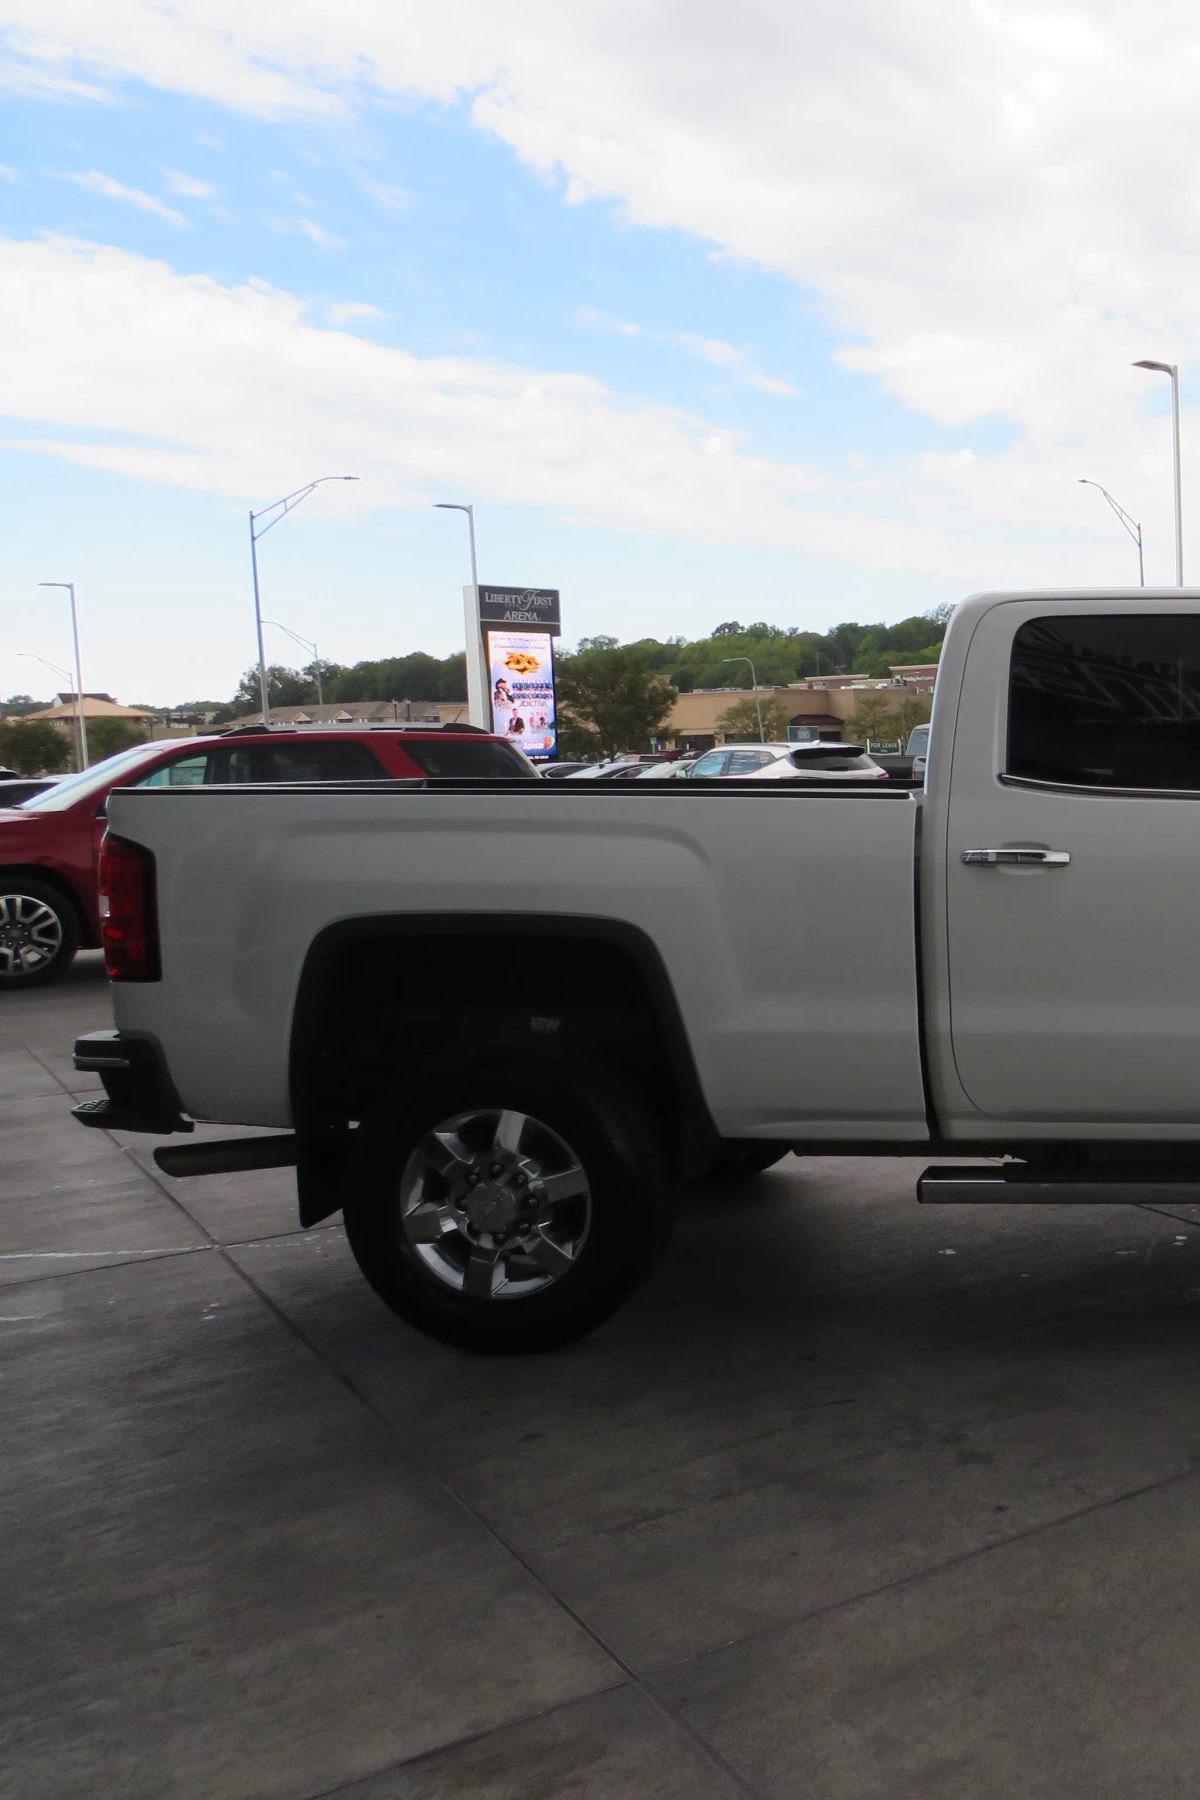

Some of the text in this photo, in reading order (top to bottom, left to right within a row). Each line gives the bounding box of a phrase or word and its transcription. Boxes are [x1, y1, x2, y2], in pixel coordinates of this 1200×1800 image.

[484, 589, 553, 610] LIBERTY FIRST
[503, 610, 538, 622] ARENA
